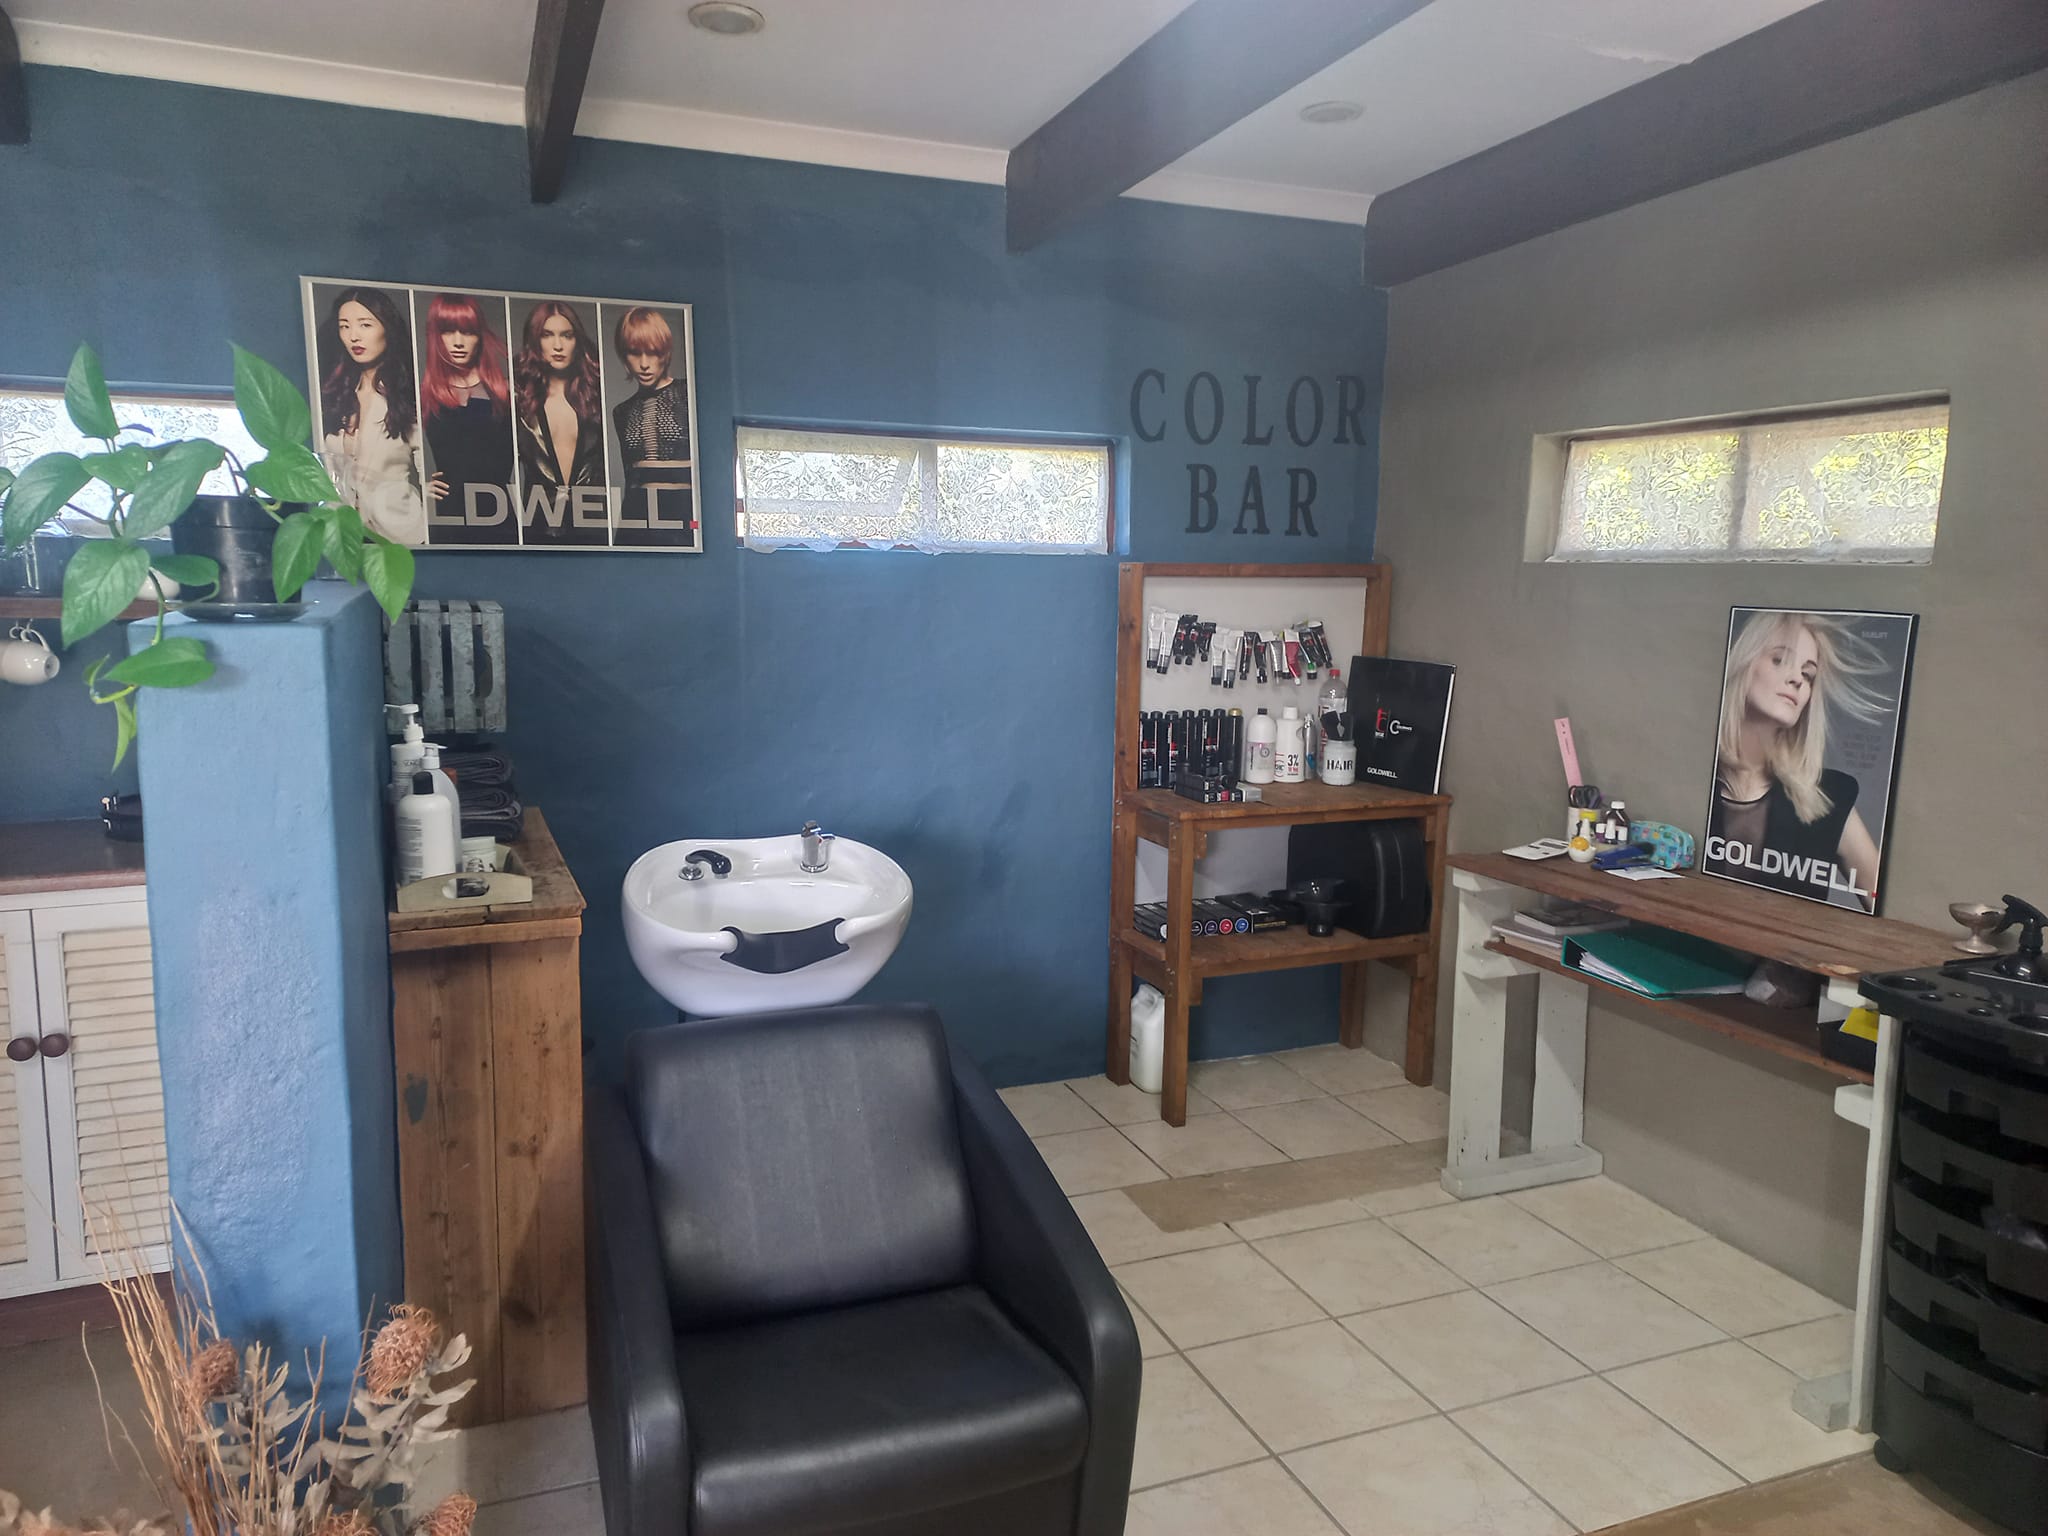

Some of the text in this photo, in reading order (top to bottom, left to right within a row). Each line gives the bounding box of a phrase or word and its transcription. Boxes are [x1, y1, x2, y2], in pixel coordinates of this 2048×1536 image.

[1130, 367, 1367, 447] COLOR
[427, 481, 684, 530] LDWELL
[1184, 463, 1319, 537] BAR
[1366, 766, 1399, 779] GOLDWELL
[1706, 836, 1868, 897] GOLDWELL
